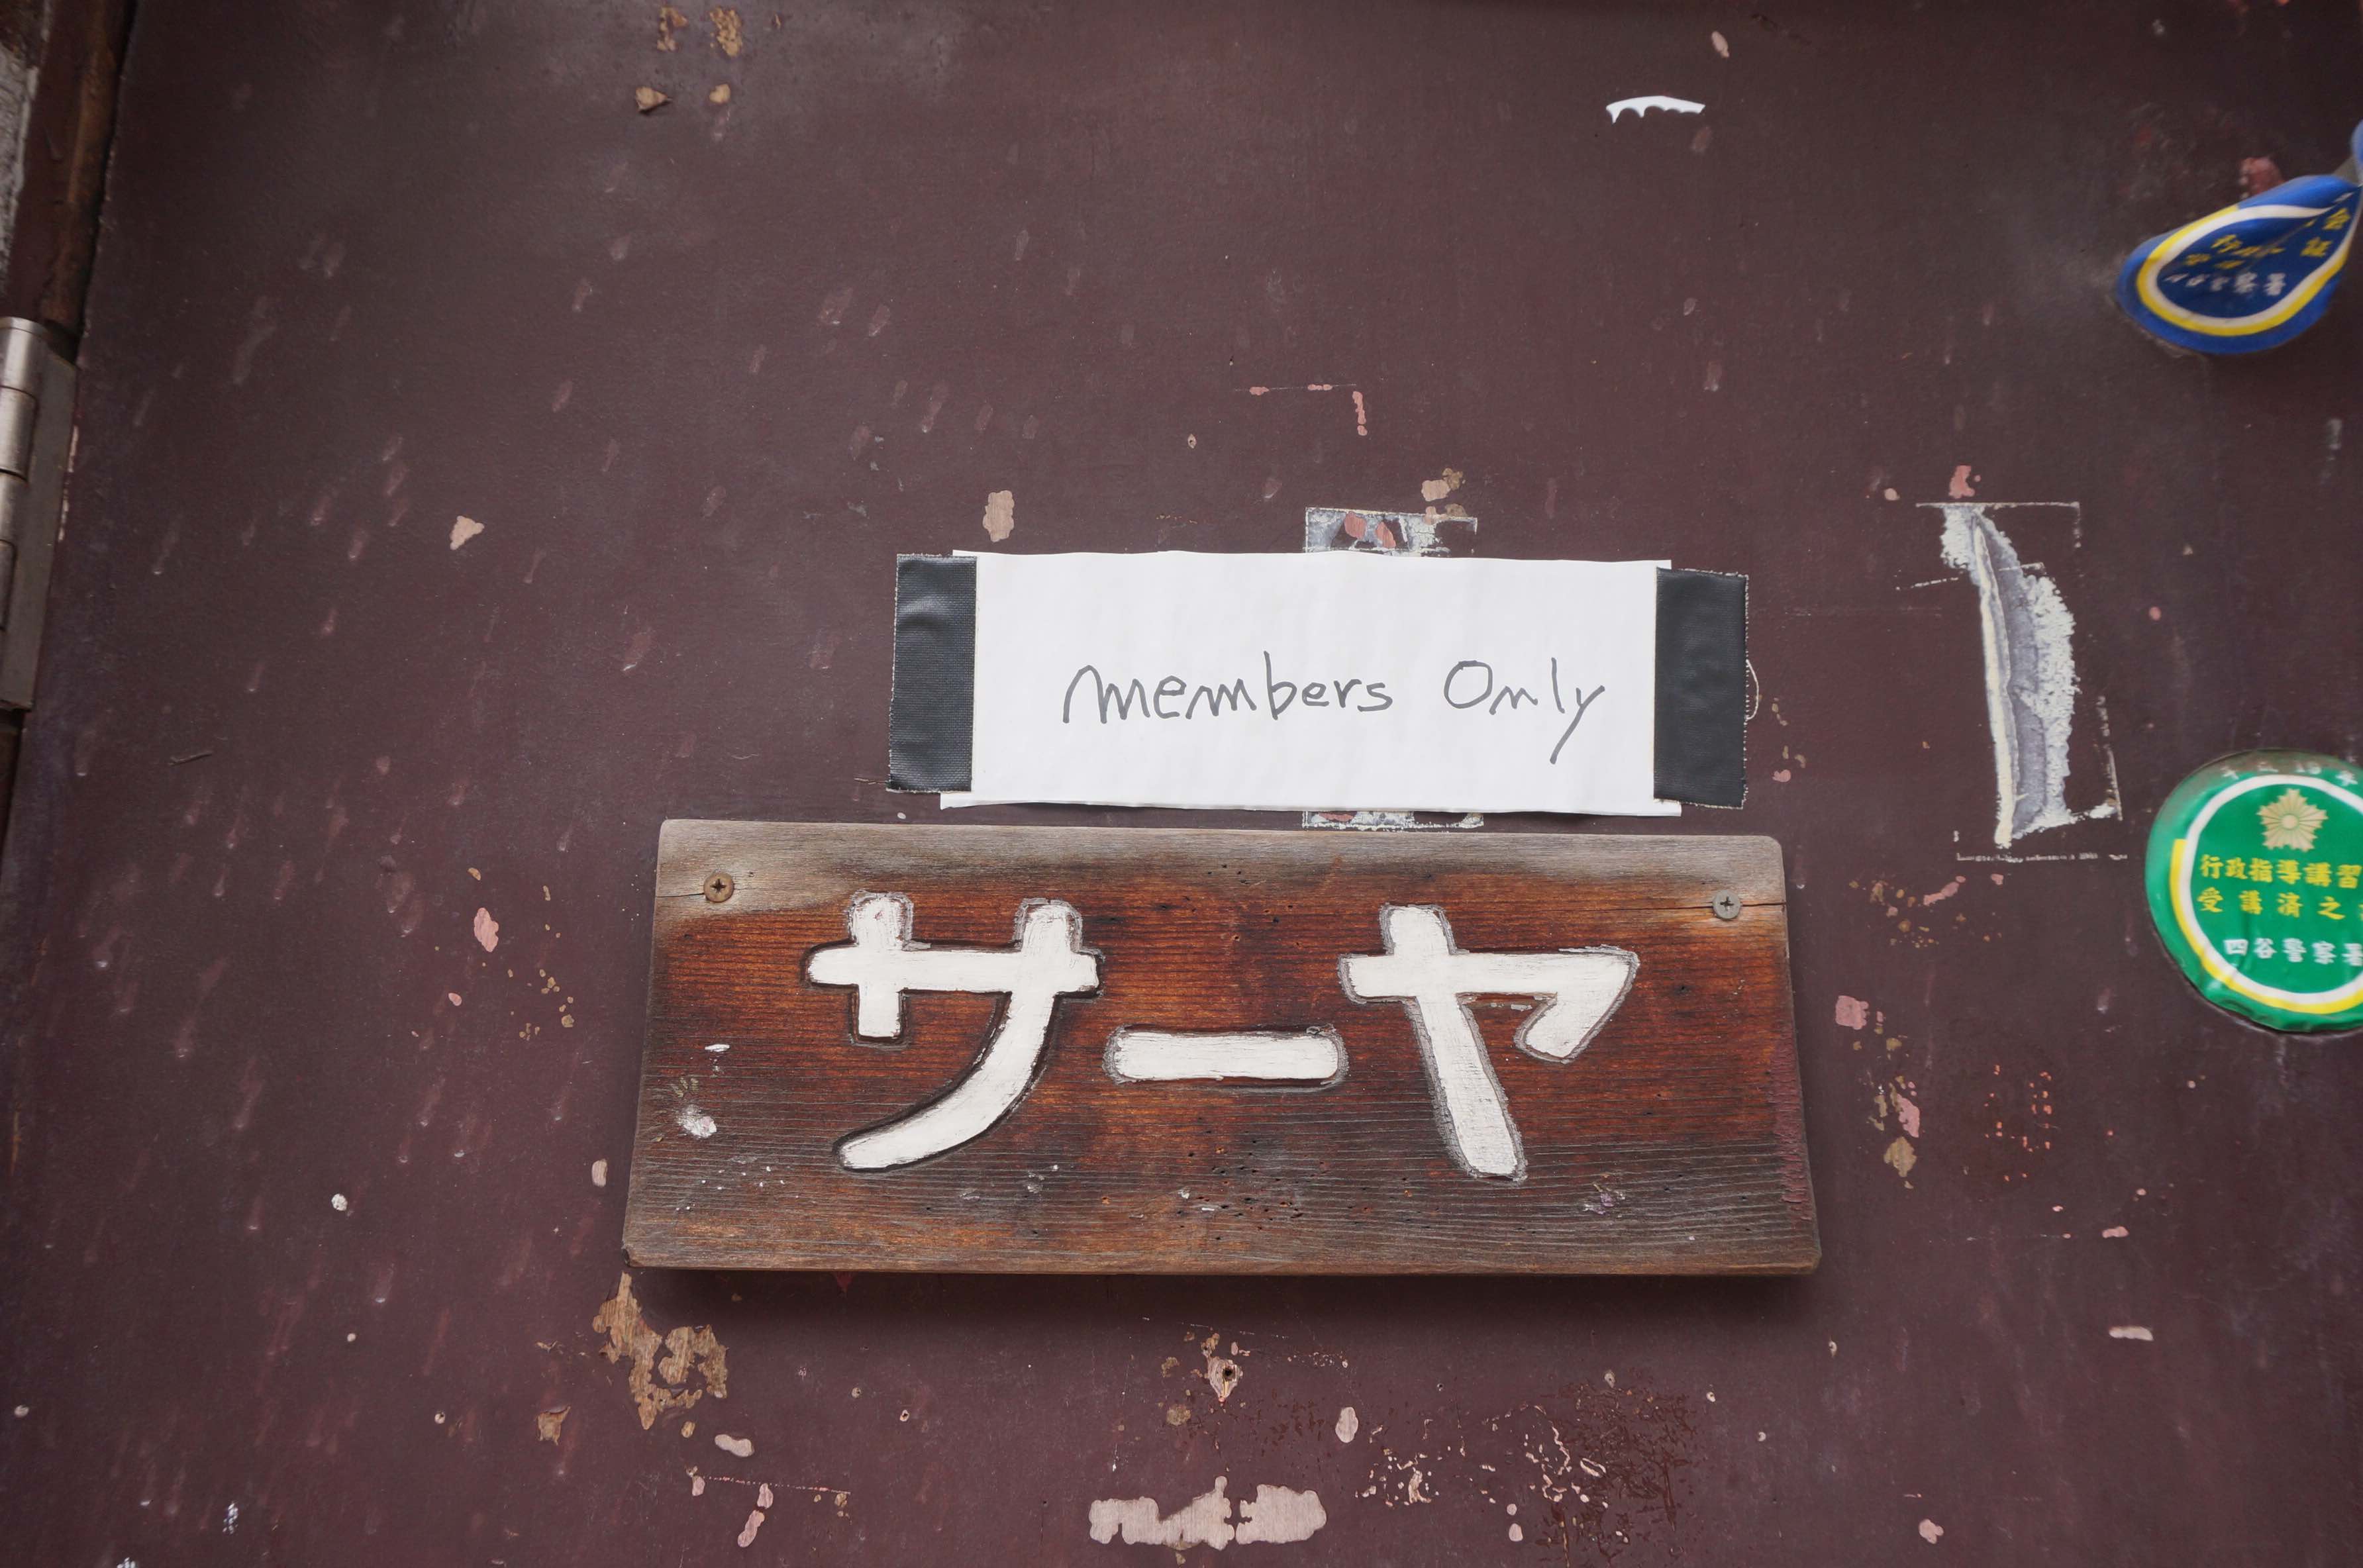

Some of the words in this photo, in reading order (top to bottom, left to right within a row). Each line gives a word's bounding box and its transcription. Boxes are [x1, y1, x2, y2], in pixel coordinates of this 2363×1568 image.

[1443, 657, 1606, 765] Only
[2197, 887, 2363, 920] 受講済之
[806, 894, 1637, 1181] サーヤ
